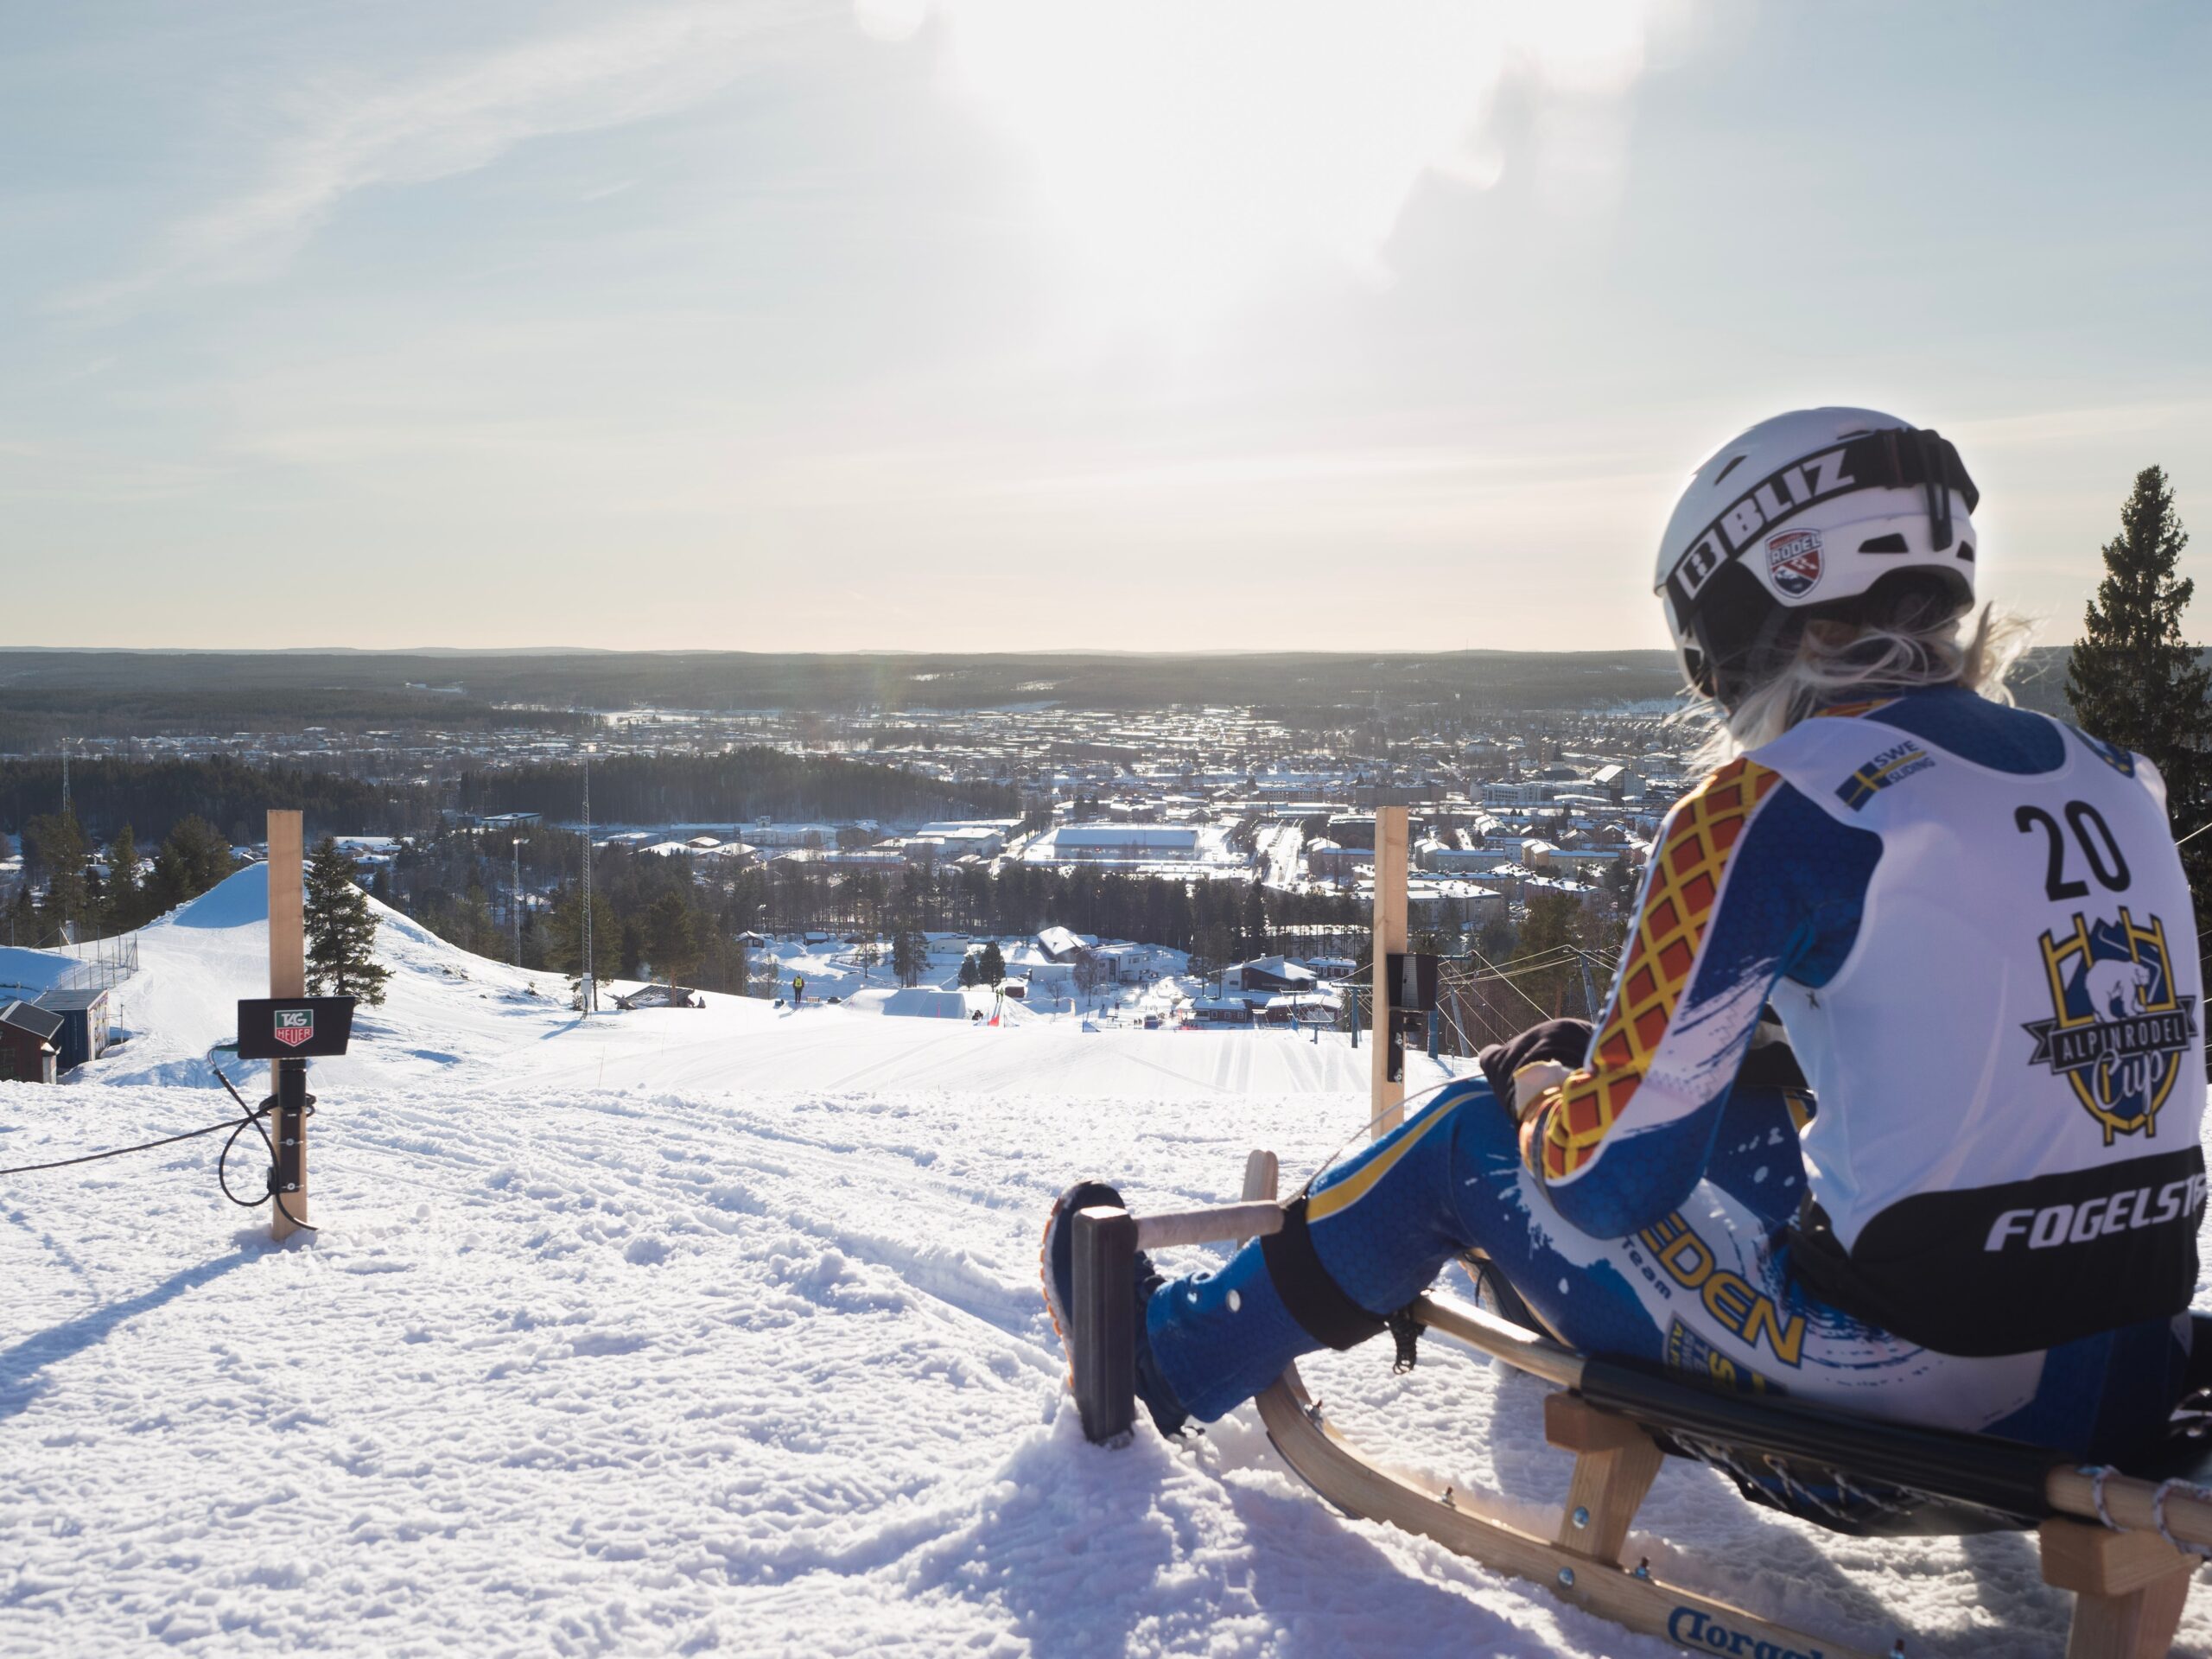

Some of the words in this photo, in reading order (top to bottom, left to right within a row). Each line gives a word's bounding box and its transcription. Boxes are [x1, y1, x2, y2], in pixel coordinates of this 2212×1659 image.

[1719, 448, 1856, 550] BLIZ
[1770, 533, 1821, 564] RODEL
[1873, 741, 1919, 767] SWE
[2014, 800, 2131, 901] 20
[277, 1028, 311, 1044] HEUER
[281, 1013, 308, 1027] TAG
[2062, 1018, 2183, 1062] ALPINRODEL
[2092, 1048, 2165, 1116] Cup
